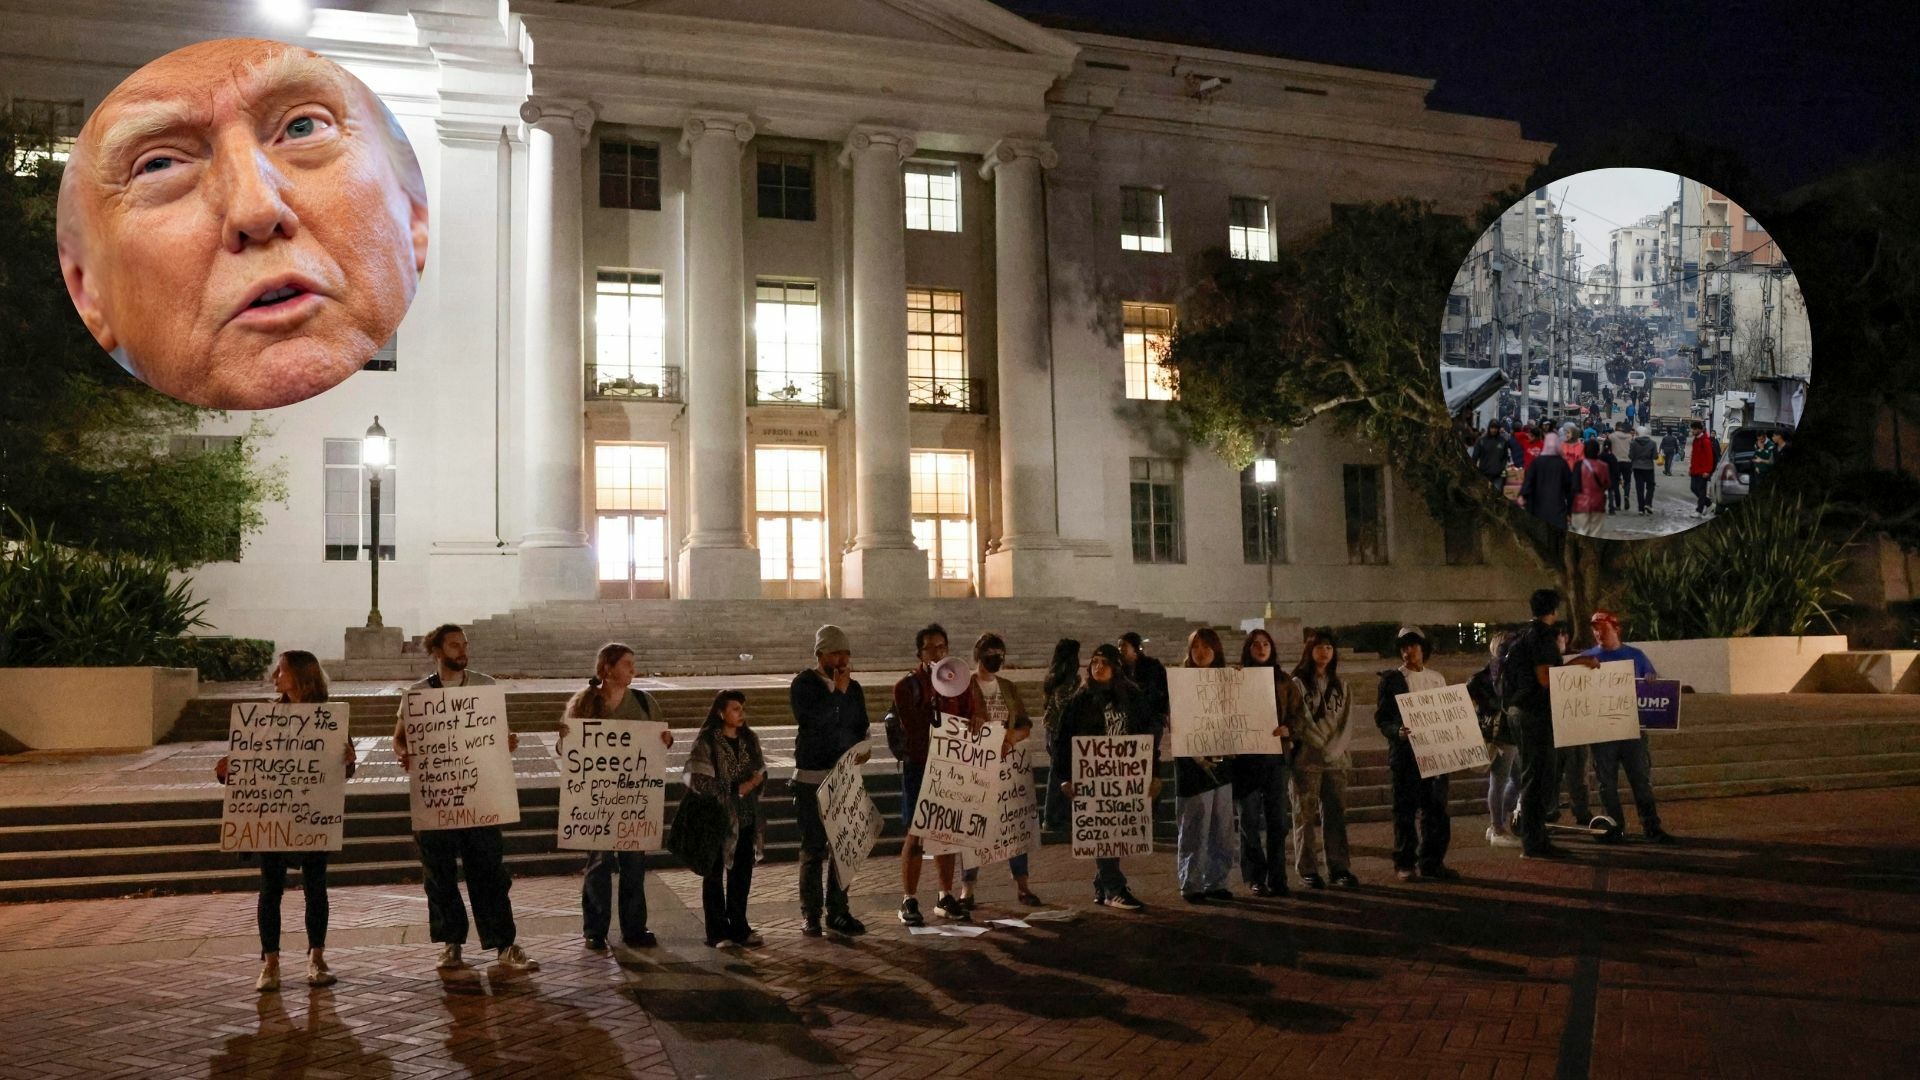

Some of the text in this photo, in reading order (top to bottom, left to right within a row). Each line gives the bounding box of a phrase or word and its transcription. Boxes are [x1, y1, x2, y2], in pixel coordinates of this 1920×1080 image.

[1556, 671, 1592, 692] YOUR
[408, 691, 479, 717] End war
[1562, 697, 1592, 719] ARE
[1637, 697, 1670, 708] UMP
[238, 705, 331, 735] Victory to
[314, 719, 338, 730] the
[407, 711, 496, 741] against Iran
[230, 730, 325, 751] Palestinian
[582, 721, 631, 748] Free
[1186, 732, 1211, 754] FOR
[407, 733, 495, 757] Israel's wars
[933, 736, 996, 770] TRUMP
[1077, 738, 1137, 758] Victory
[230, 758, 320, 774] STRUGGLE
[419, 755, 475, 770] of ethnic
[568, 748, 647, 779] Speech
[1079, 759, 1148, 779] Palestine!
[226, 772, 256, 786] End
[278, 772, 325, 786] Israeli
[419, 767, 478, 785] cleansing
[567, 773, 664, 796] for pro-Palestine
[232, 788, 293, 800] invasion
[420, 783, 476, 798] threaten
[1074, 780, 1096, 798] End
[1125, 778, 1144, 796] Aid
[228, 802, 310, 819] occupation
[295, 811, 342, 825] of Gaza
[438, 810, 499, 827] BAMN.com
[570, 805, 646, 823] faculty and
[915, 800, 987, 838] SPROUL 5PM
[1076, 814, 1137, 827] Genocide
[223, 821, 328, 850] BAMN.com
[563, 821, 657, 842] groups BAMN
[1000, 821, 1015, 836] win
[1076, 829, 1109, 841] Gaza
